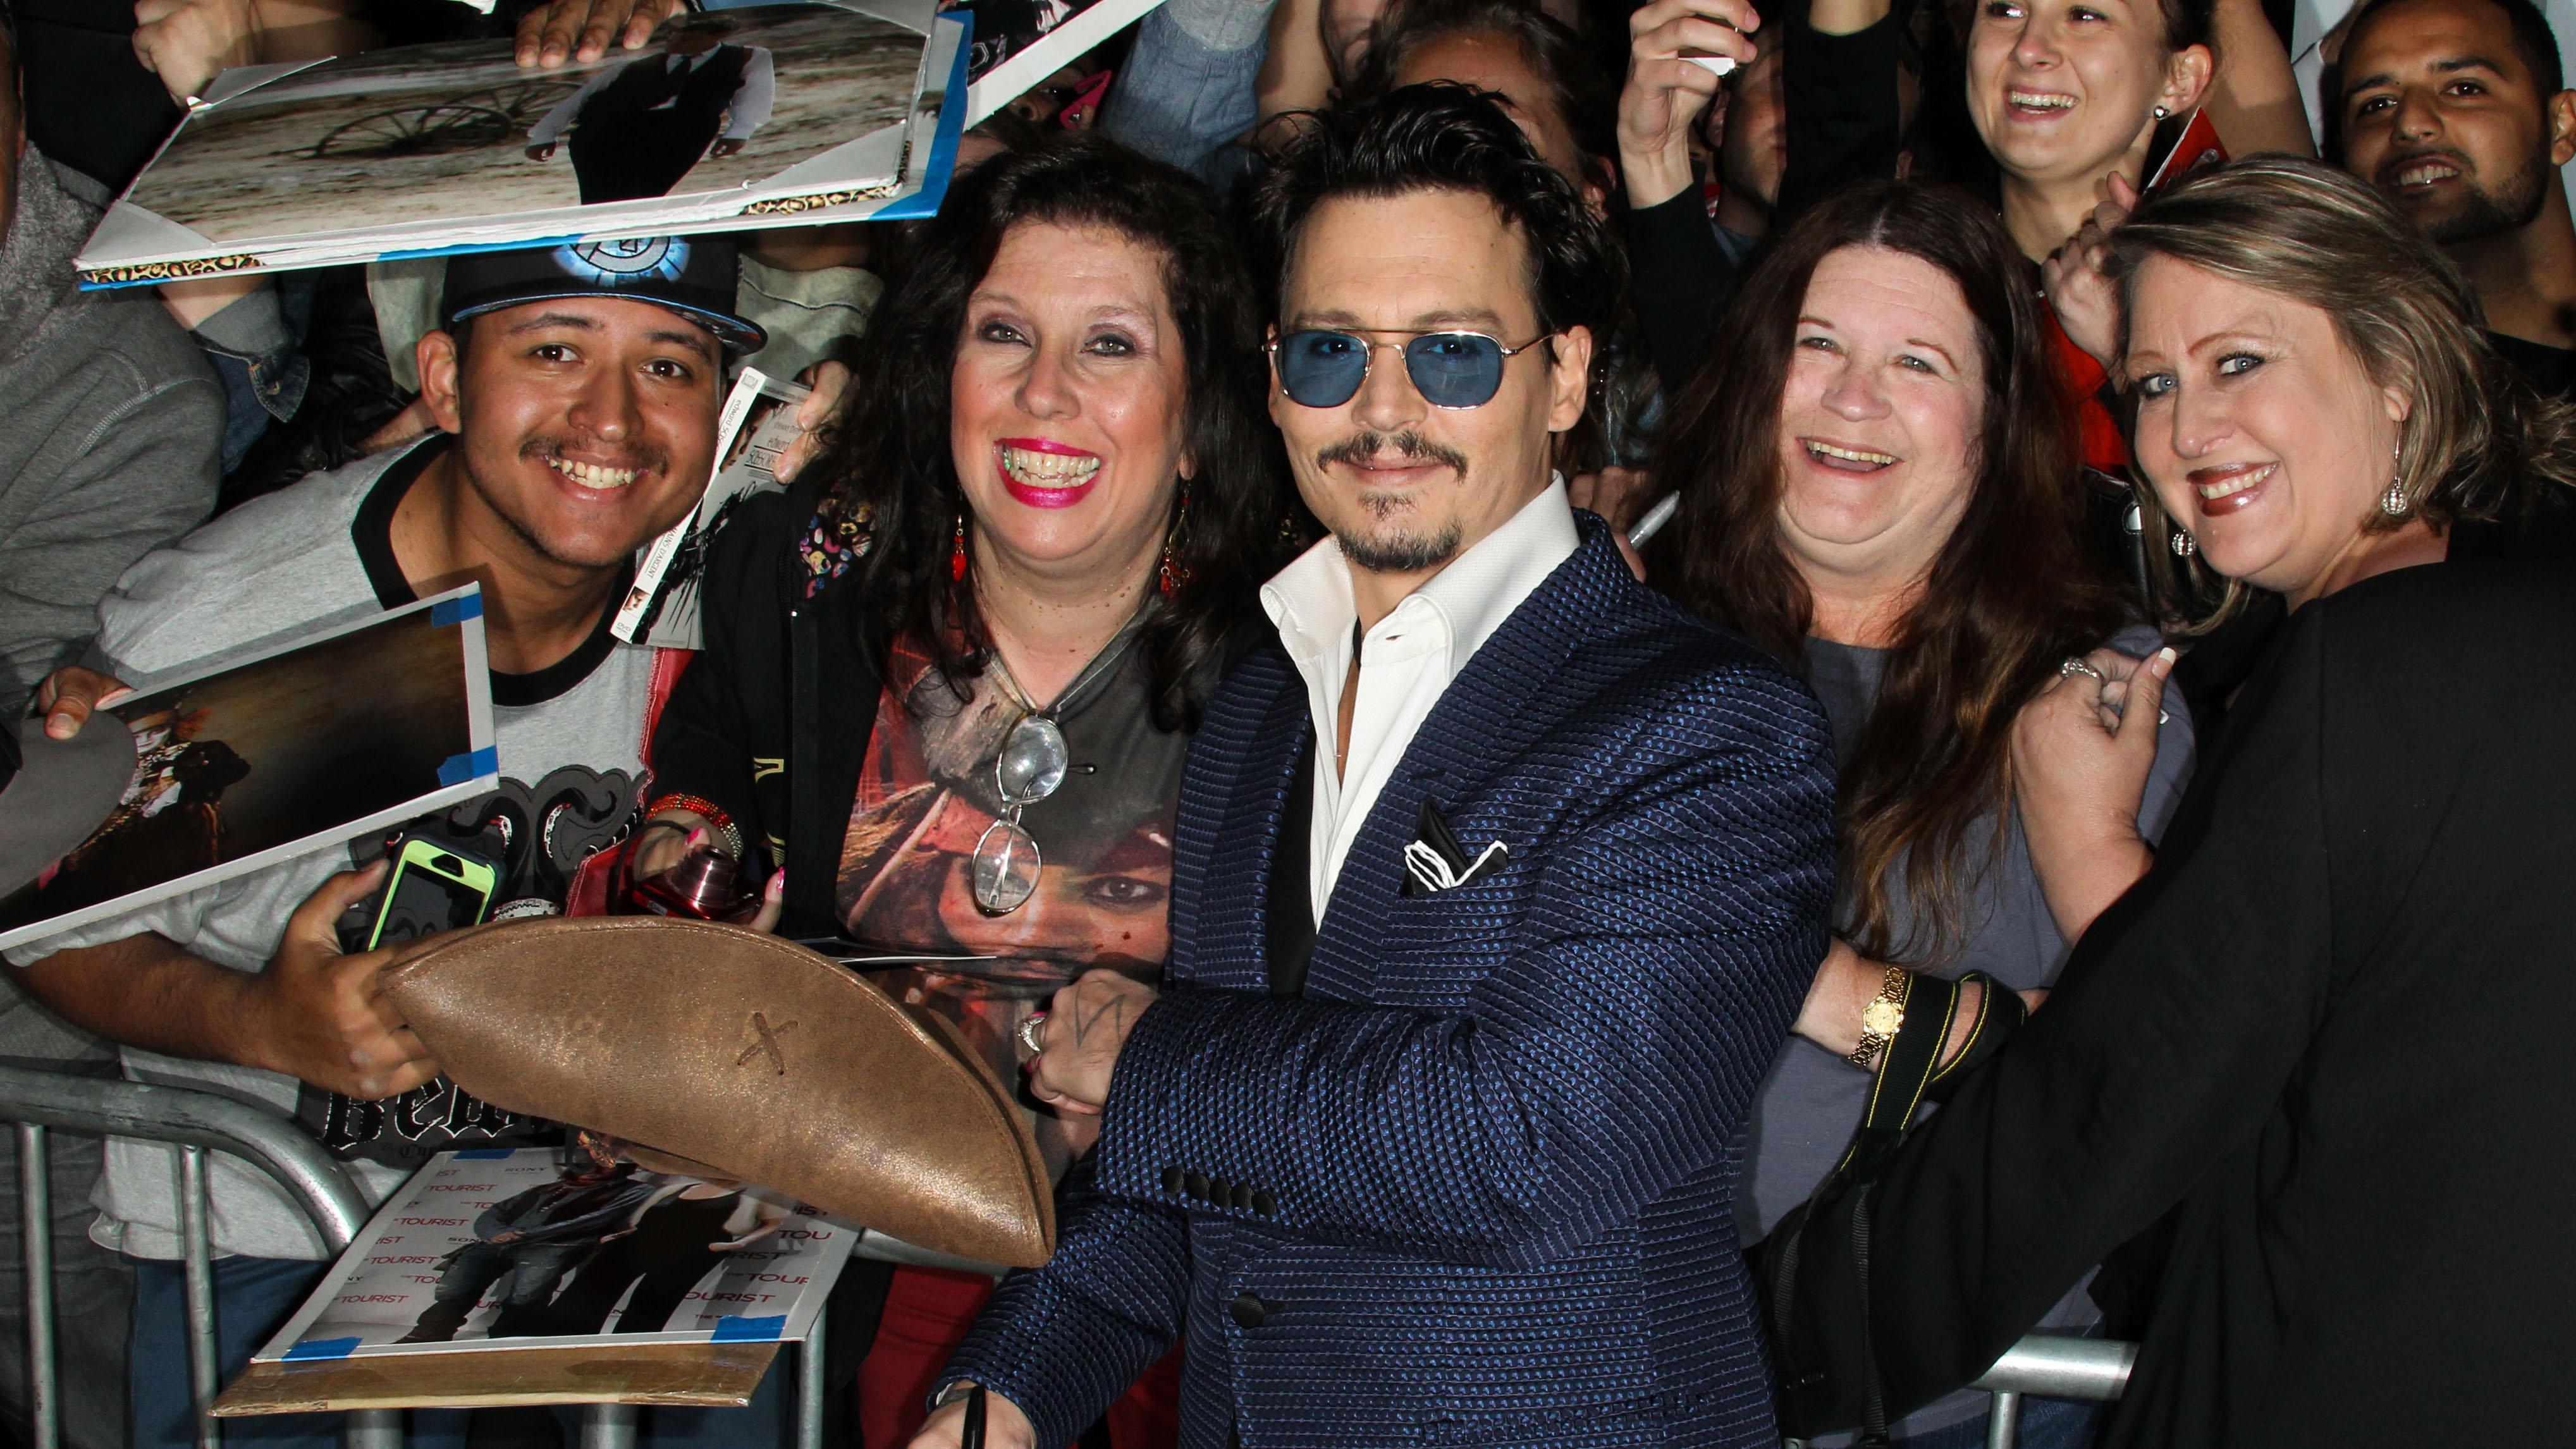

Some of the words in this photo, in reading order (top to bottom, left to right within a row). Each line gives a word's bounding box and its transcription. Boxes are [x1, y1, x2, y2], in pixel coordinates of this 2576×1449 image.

[727, 400, 742, 425] edward
[401, 1218, 469, 1226] TOURIST
[778, 1230, 832, 1240] TOU
[370, 1256, 439, 1264] TOURIST
[728, 1252, 787, 1260] RIST
[341, 1295, 410, 1303] TOURIST
[685, 1292, 776, 1302] OURIST
